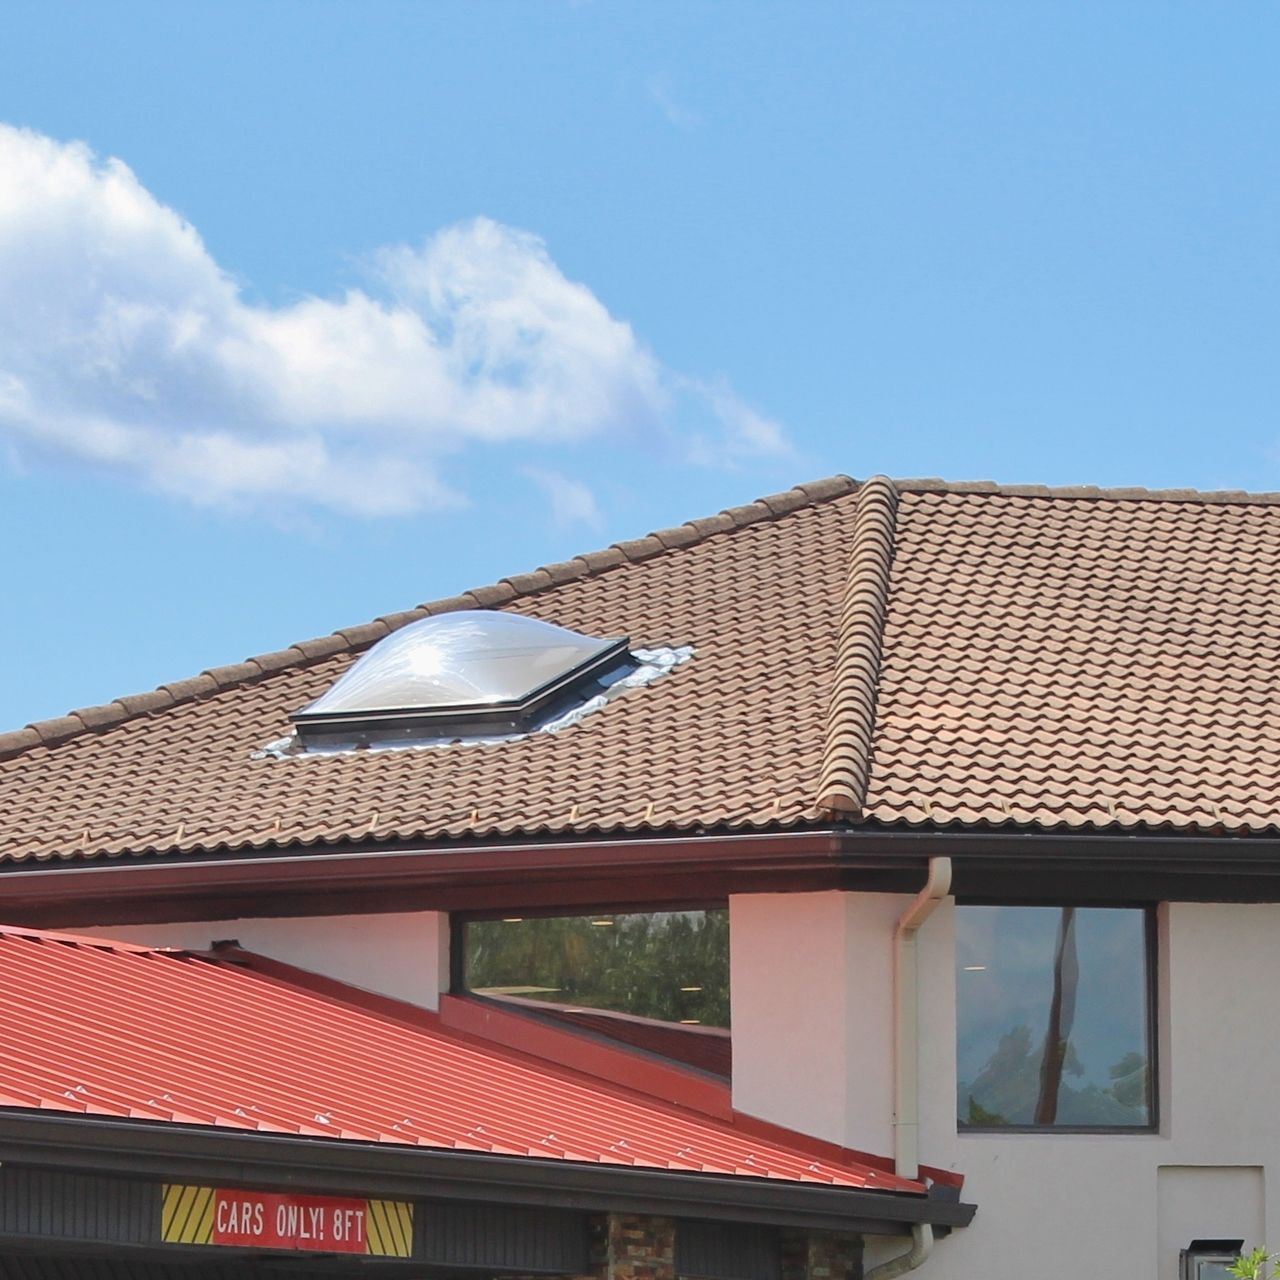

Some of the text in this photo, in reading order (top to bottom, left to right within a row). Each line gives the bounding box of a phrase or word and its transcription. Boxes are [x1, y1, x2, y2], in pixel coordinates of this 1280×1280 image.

[217, 1200, 364, 1242] CARS ONLY! 8FT
